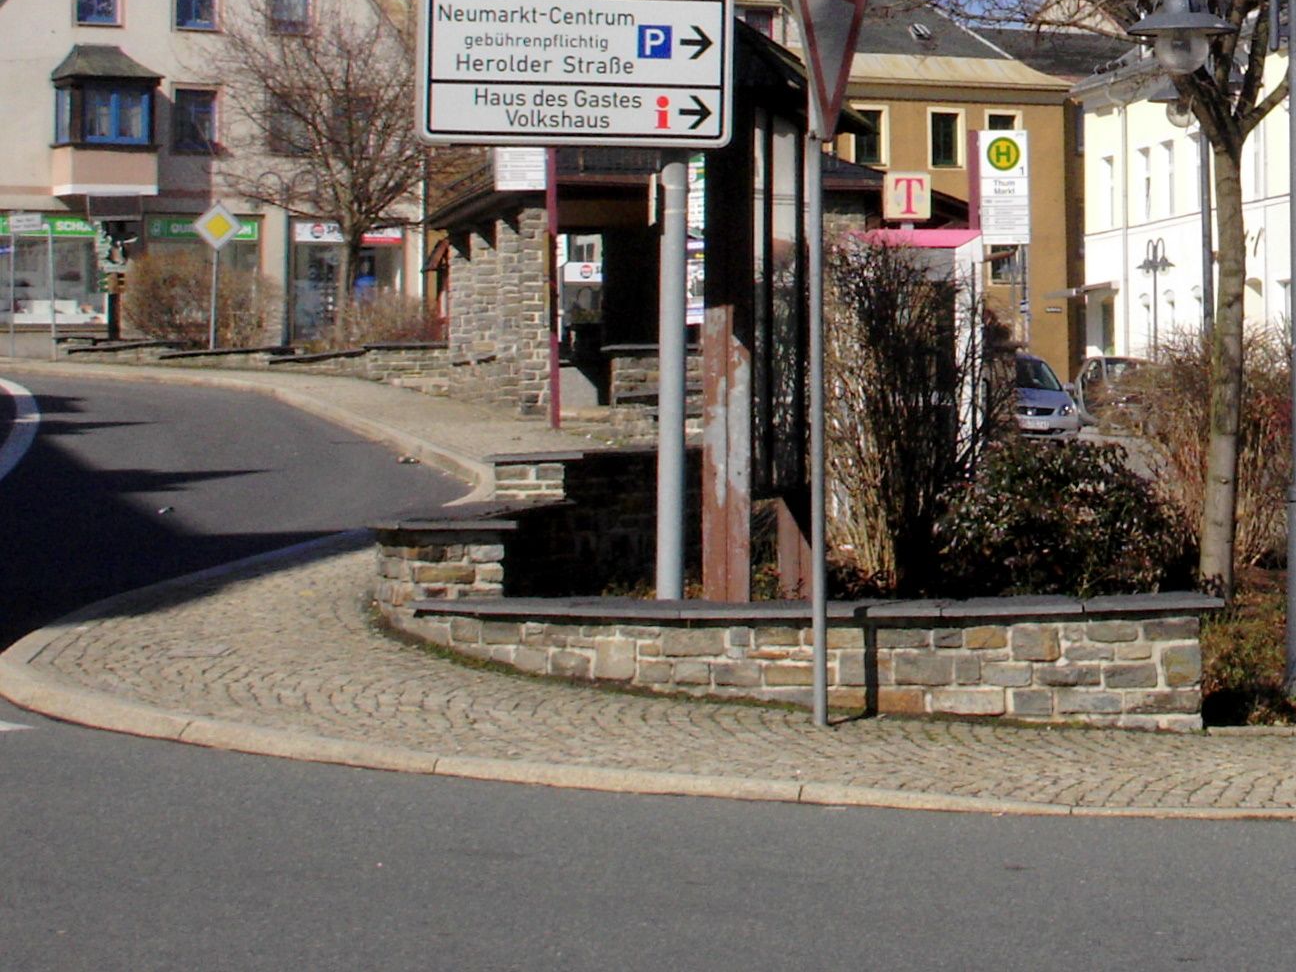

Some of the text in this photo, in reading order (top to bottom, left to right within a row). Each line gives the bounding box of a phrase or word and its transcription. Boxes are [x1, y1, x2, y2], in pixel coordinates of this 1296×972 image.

[438, 4, 635, 27] Neumarkt-Centrum
[464, 33, 609, 53] gebührenpflichtig
[644, 30, 664, 55] P
[456, 54, 634, 75] Herolder Straße
[474, 88, 643, 109] Haus des Gastes
[505, 109, 611, 129] Volkshaus
[995, 145, 1011, 163] H
[894, 178, 924, 215] T
